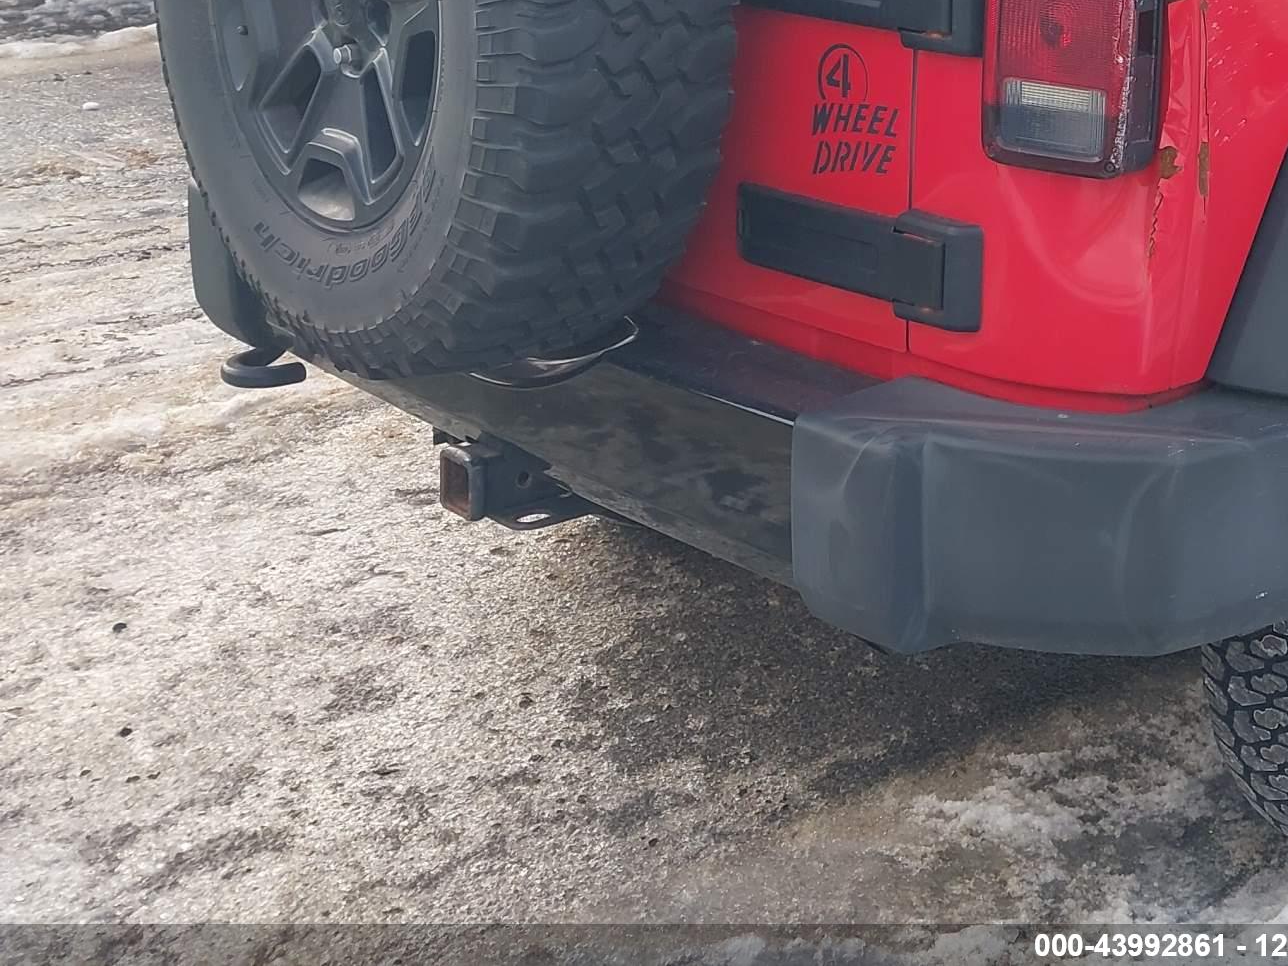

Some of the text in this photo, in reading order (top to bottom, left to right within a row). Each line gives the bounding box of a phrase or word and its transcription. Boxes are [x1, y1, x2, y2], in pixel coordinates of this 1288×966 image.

[825, 53, 852, 99] 4
[811, 102, 900, 138] WHEEL
[812, 140, 897, 175] DRIVE
